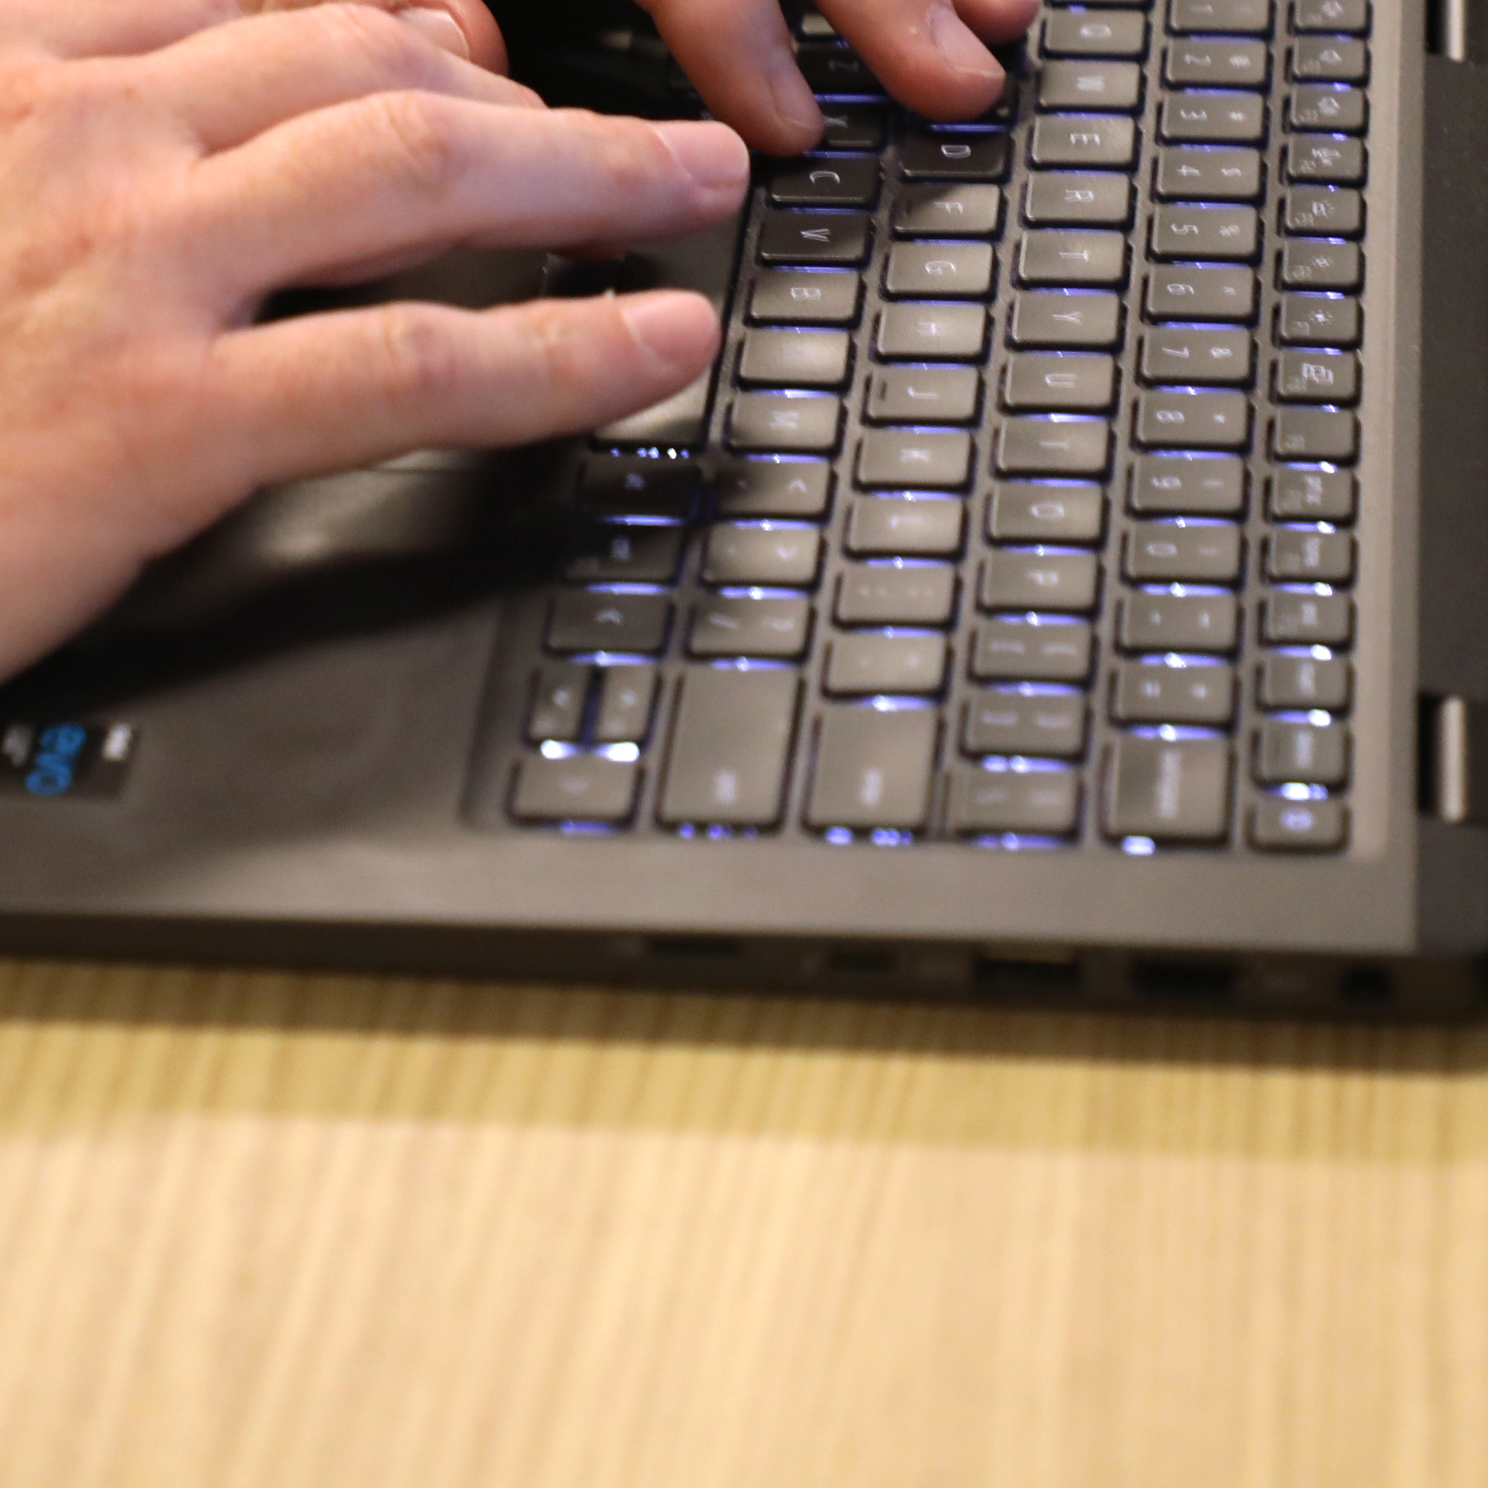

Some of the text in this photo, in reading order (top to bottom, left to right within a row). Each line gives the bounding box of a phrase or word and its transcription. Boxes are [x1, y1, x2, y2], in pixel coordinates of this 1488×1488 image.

[1184, 54, 1212, 64] 2
[1180, 110, 1208, 120] 3
[1069, 133, 1101, 146] E
[941, 144, 972, 159] D
[809, 170, 841, 185] C
[1177, 165, 1202, 177] 4
[1064, 189, 1095, 203] R
[933, 201, 964, 214] F
[800, 227, 833, 243] V
[1170, 224, 1200, 236] 5
[1058, 249, 1090, 262] T
[924, 260, 957, 275] G
[790, 287, 822, 300] B
[1167, 283, 1195, 296] 6
[1052, 312, 1083, 326] Y
[917, 322, 945, 336] H
[1162, 346, 1190, 359] 7
[1045, 373, 1076, 389] U
[907, 387, 940, 399] J
[1155, 410, 1186, 424] 8
[1151, 475, 1182, 491] 9
